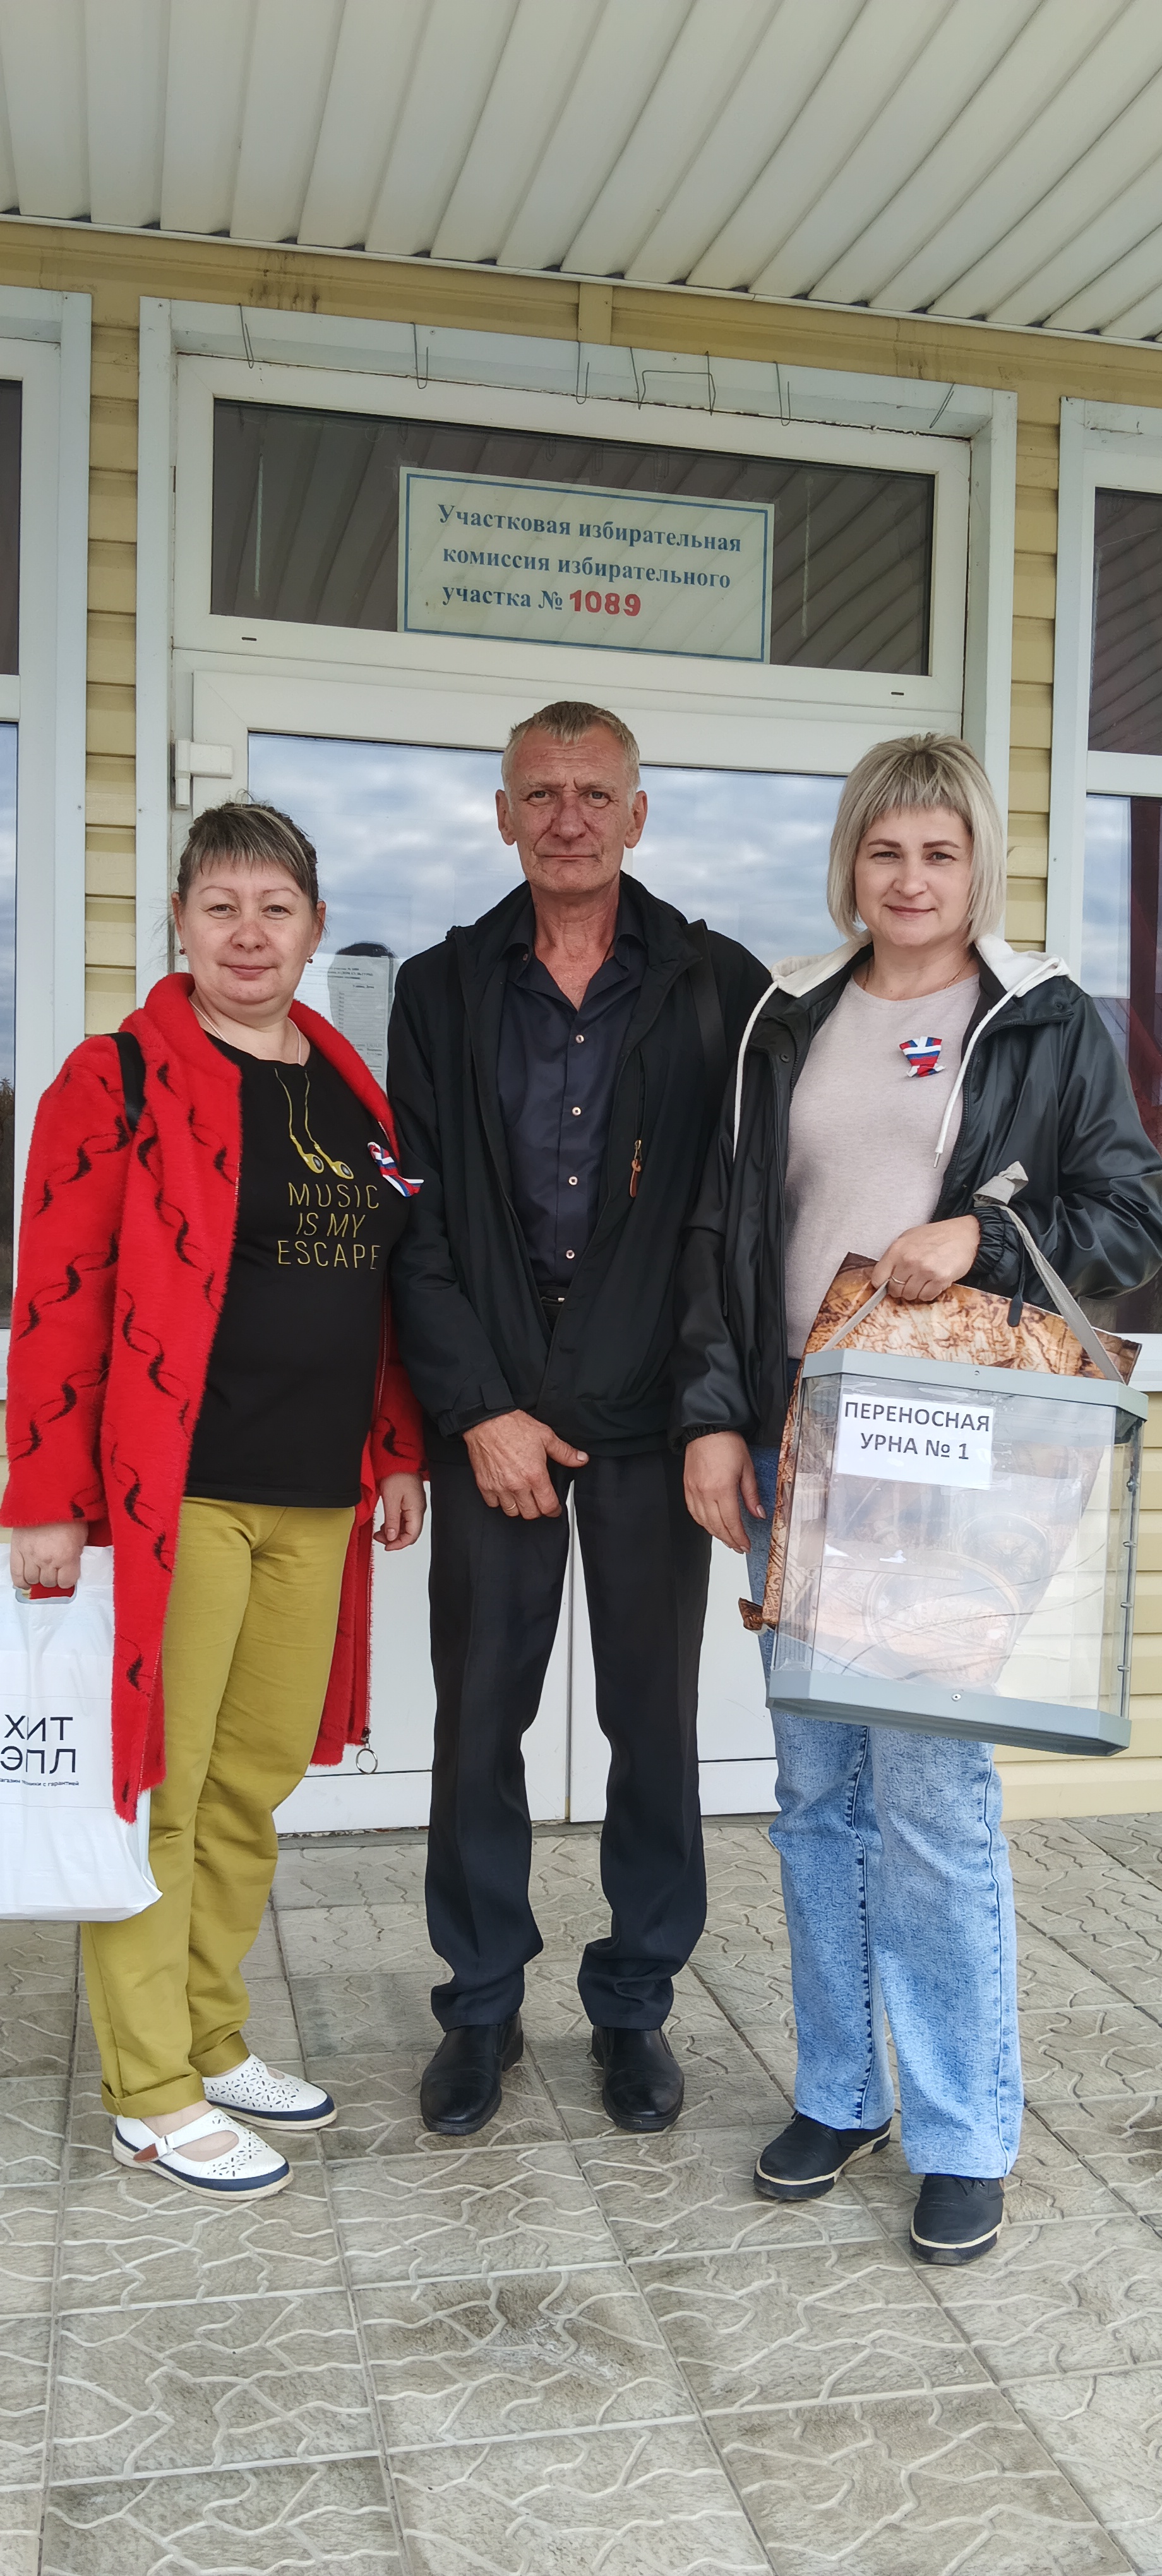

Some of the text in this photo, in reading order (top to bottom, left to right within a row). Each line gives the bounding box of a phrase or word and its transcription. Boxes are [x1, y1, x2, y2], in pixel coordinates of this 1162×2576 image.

[436, 503, 741, 552] Участковая избирательная
[443, 547, 731, 589] комиссия избирательного
[442, 585, 642, 617] участка № 1089
[288, 1182, 380, 1209] MUSIC
[296, 1212, 366, 1238] IS MY
[277, 1240, 381, 1270] ESCAPE
[844, 1401, 990, 1432] ПЕРЕНОСНАЯ
[861, 1433, 969, 1460] УРНА № 1
[4, 1714, 73, 1742] ХИТ
[0, 1745, 76, 1774] ЭПЛ
